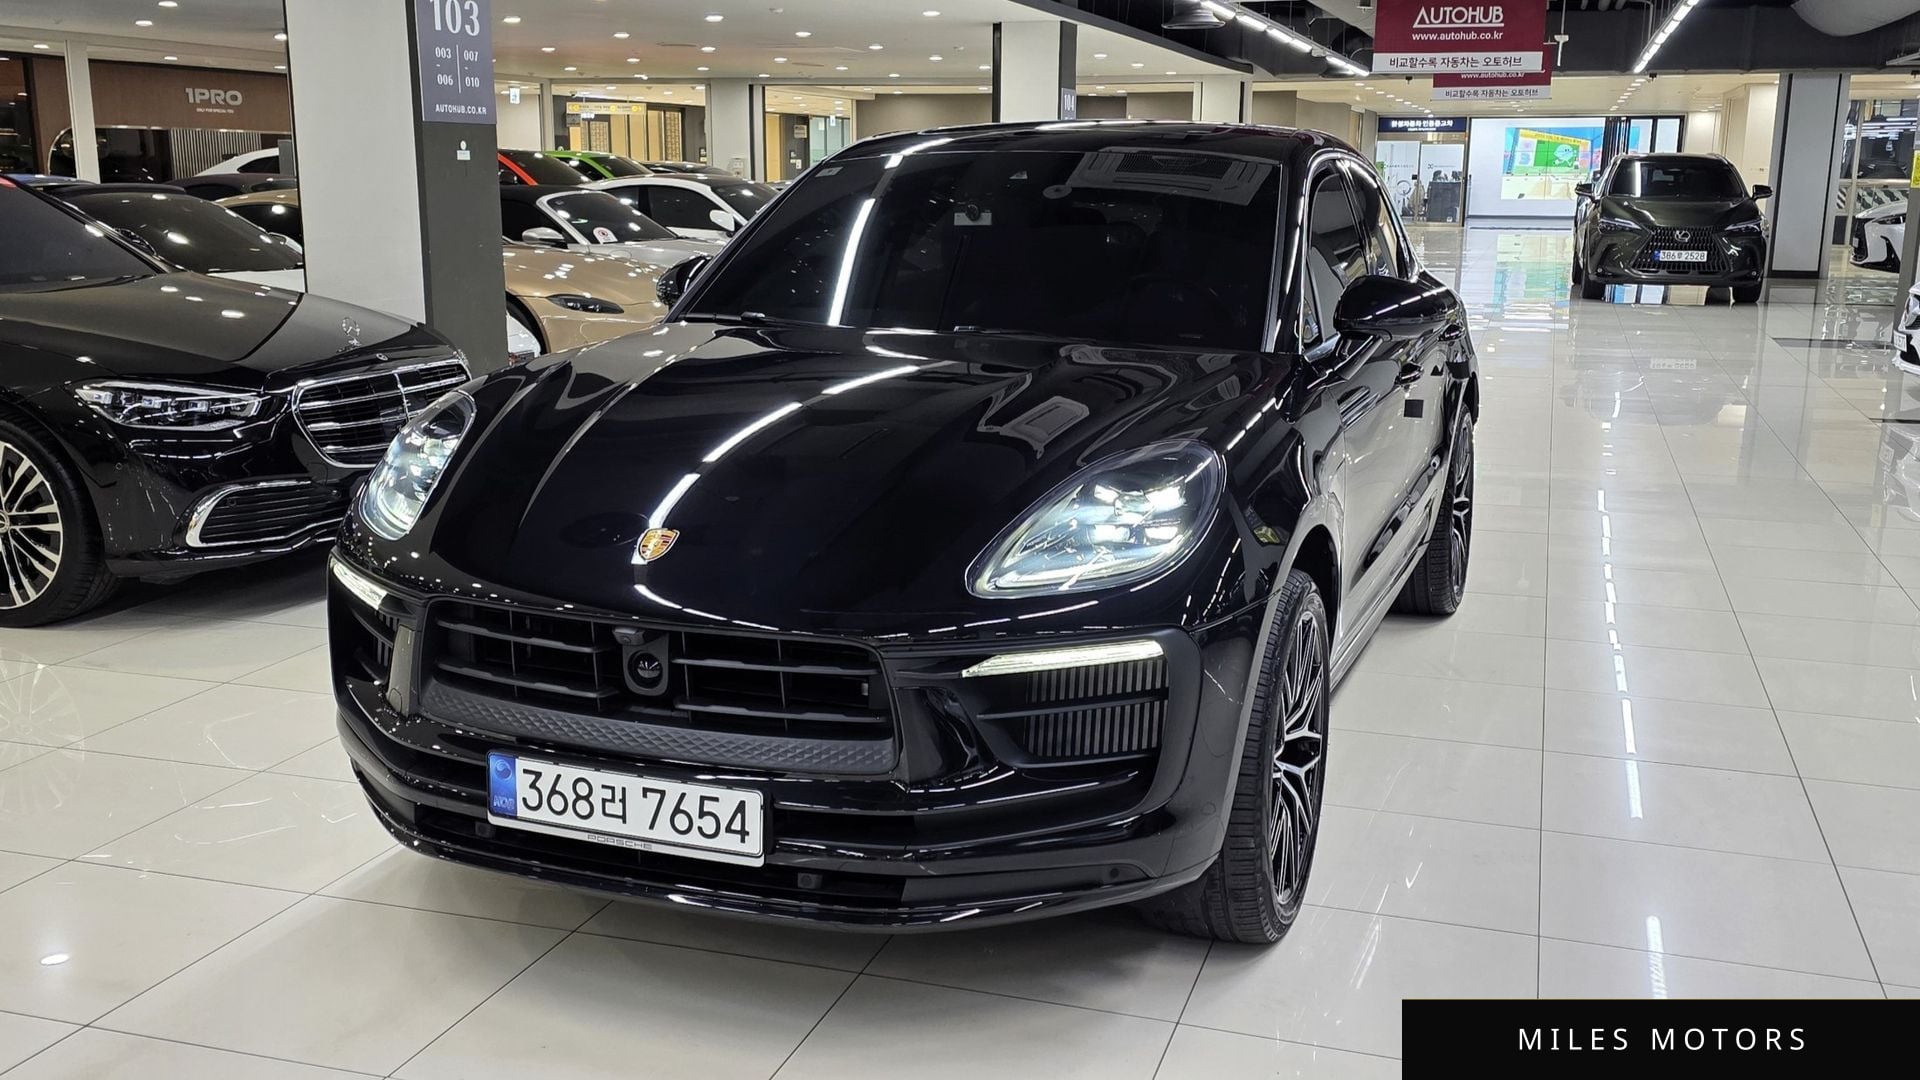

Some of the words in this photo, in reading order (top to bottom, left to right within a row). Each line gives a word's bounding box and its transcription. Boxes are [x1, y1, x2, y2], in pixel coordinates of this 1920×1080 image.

[430, 0, 480, 36] 103
[1412, 6, 1505, 28] AUTOHUB
[1412, 31, 1503, 41] www.autohub.co.kr
[435, 47, 452, 59] 003
[463, 50, 479, 62] 007
[1389, 57, 1439, 69] 비교할수록
[1440, 57, 1480, 68] 자동차는
[1482, 56, 1523, 67] 오토허브
[437, 74, 454, 86] 006
[465, 77, 480, 87] 010
[185, 88, 243, 106] 1PRO
[435, 104, 487, 115] AUTOHUB.CO.KR
[1684, 252, 1706, 261] 2528
[522, 768, 626, 824] 368러
[642, 787, 750, 844] 7654
[587, 834, 653, 849] PORSCHE
